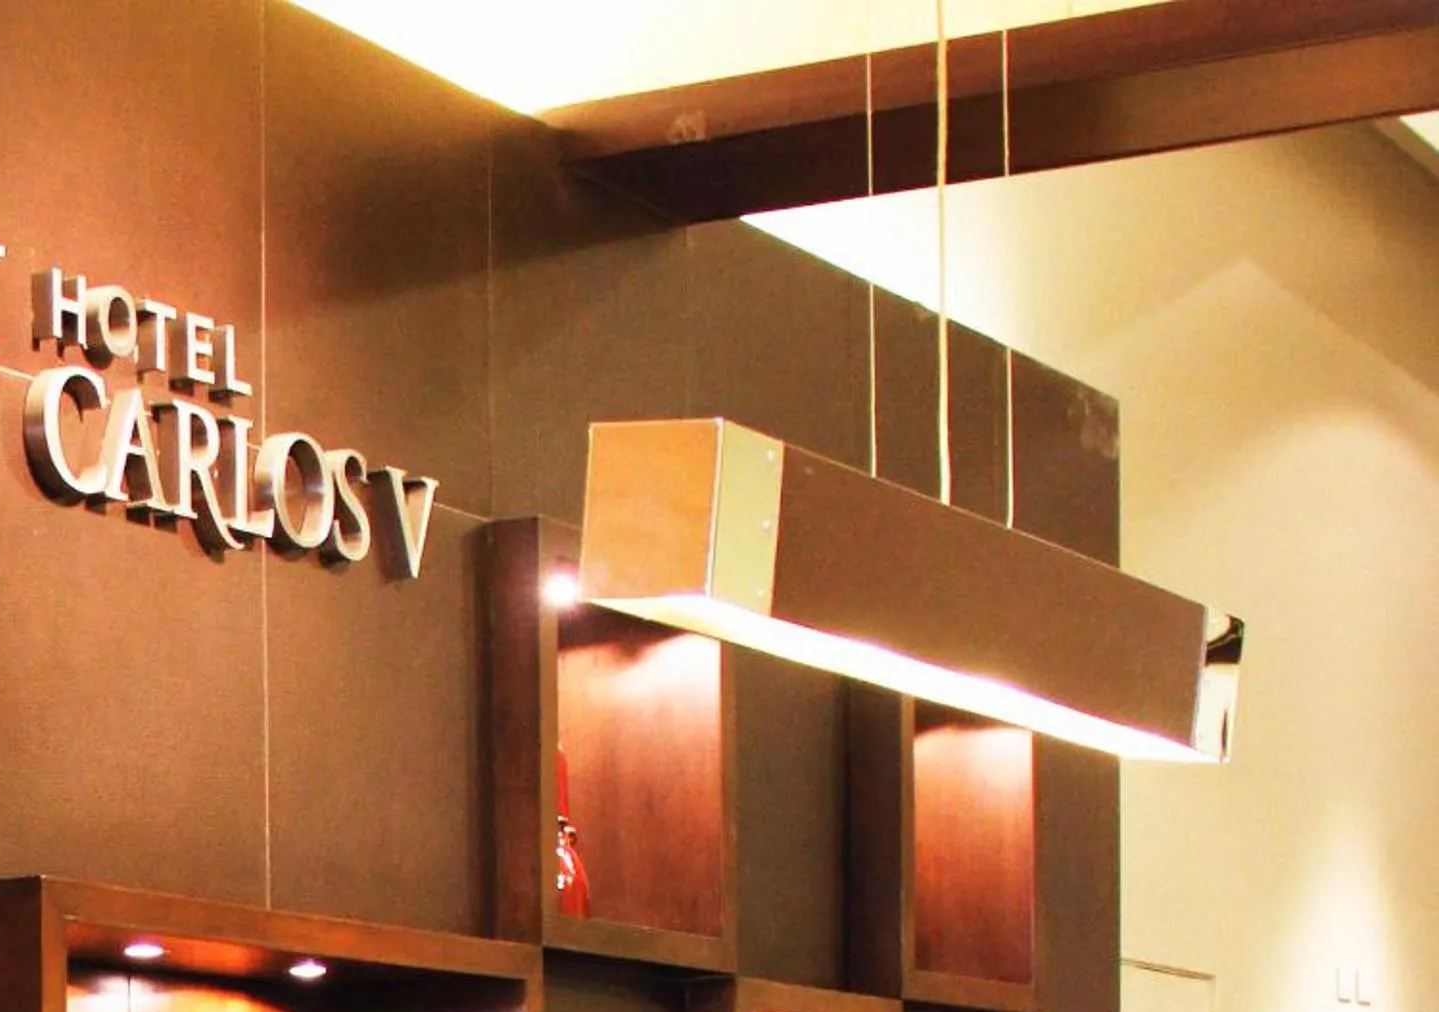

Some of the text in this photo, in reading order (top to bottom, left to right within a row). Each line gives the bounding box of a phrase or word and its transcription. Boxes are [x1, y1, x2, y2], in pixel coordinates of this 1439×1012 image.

[33, 266, 252, 396] HOTEL
[23, 364, 440, 580] CARLOS V
